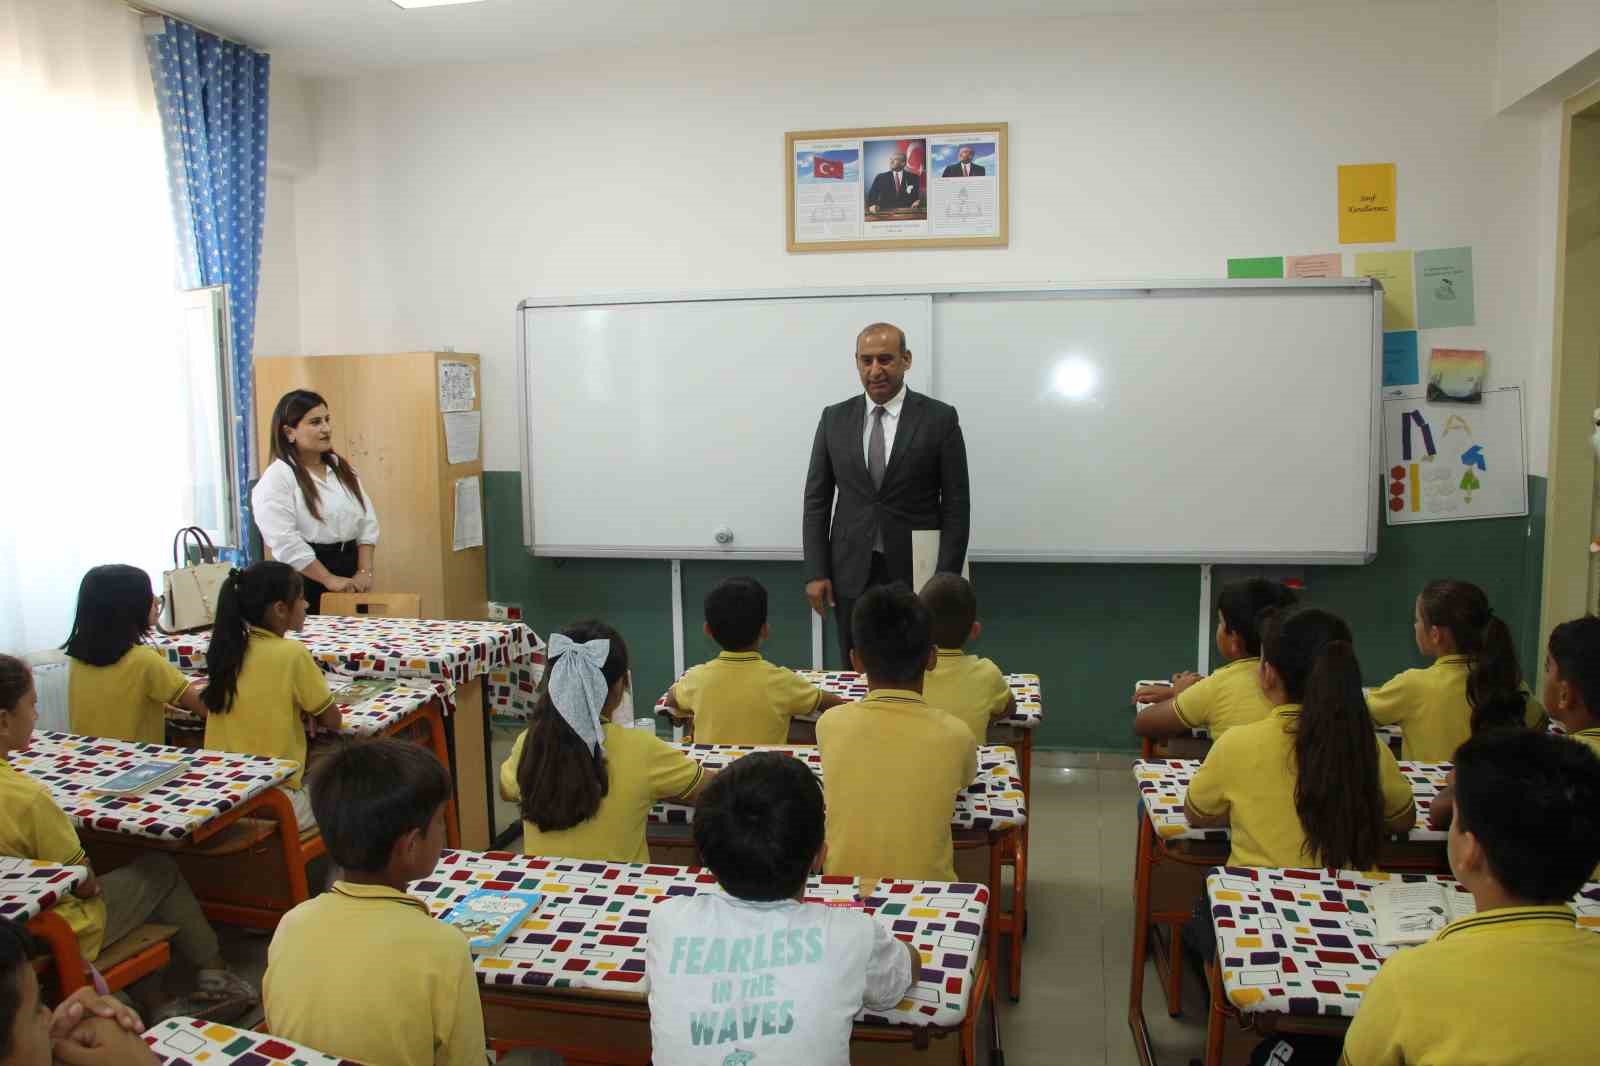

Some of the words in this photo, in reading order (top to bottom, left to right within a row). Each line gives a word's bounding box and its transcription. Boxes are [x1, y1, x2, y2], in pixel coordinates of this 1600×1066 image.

[671, 928, 823, 974] FEARLESS
[711, 980, 733, 1004] IN
[743, 974, 775, 998] THE
[690, 1000, 794, 1046] WAVES
